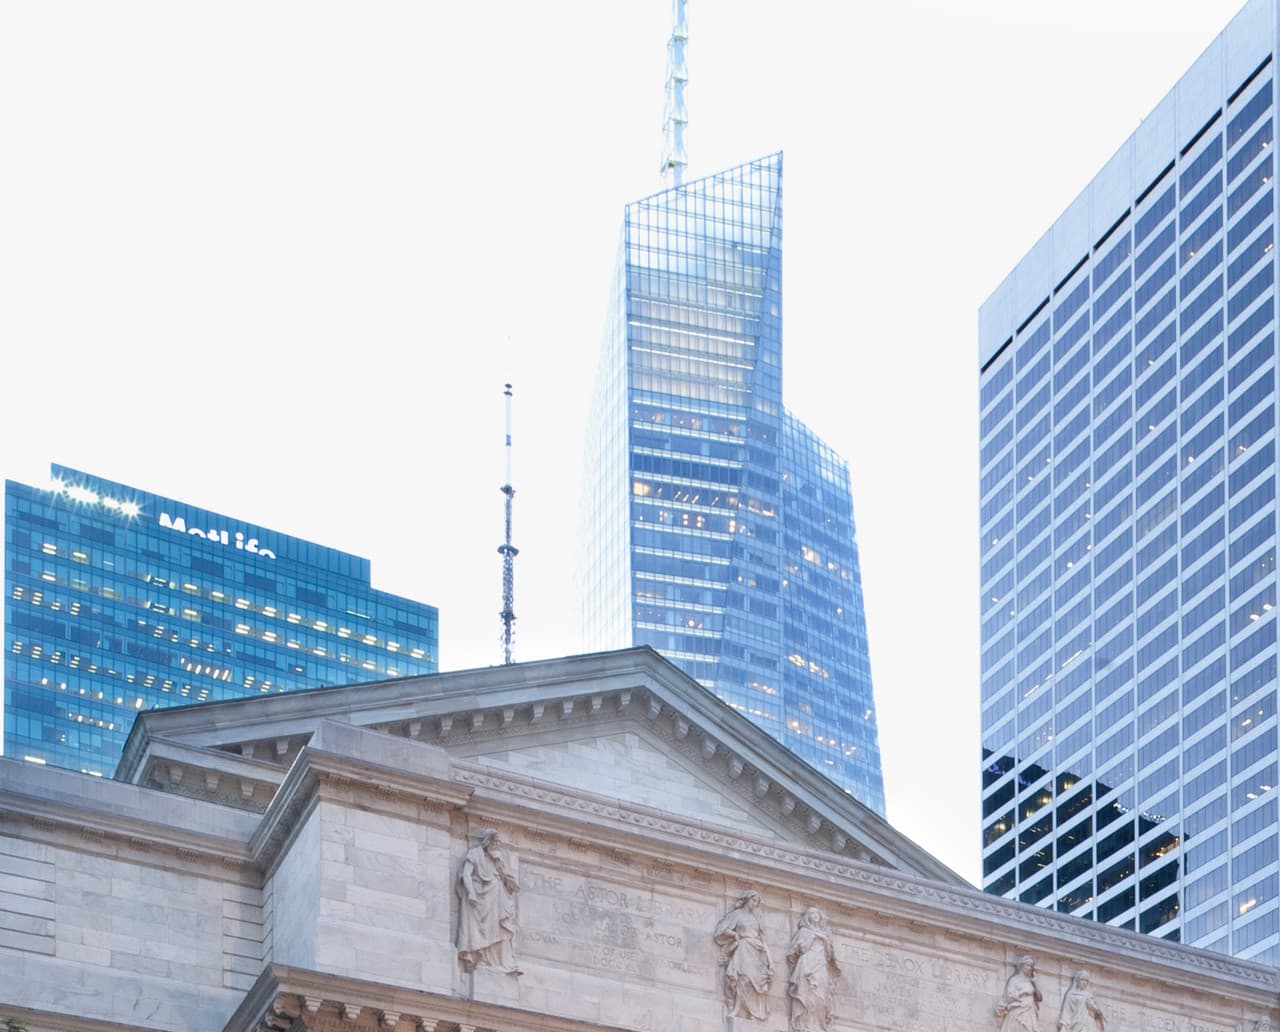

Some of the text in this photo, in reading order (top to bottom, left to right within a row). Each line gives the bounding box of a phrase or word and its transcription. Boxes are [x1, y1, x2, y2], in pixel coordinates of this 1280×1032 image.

[575, 884, 628, 909] ASTOR
[635, 896, 709, 921] LIBRARY
[645, 933, 683, 949] ASTOR
[877, 952, 926, 976] LENOX
[931, 961, 990, 986] LIBRARY
